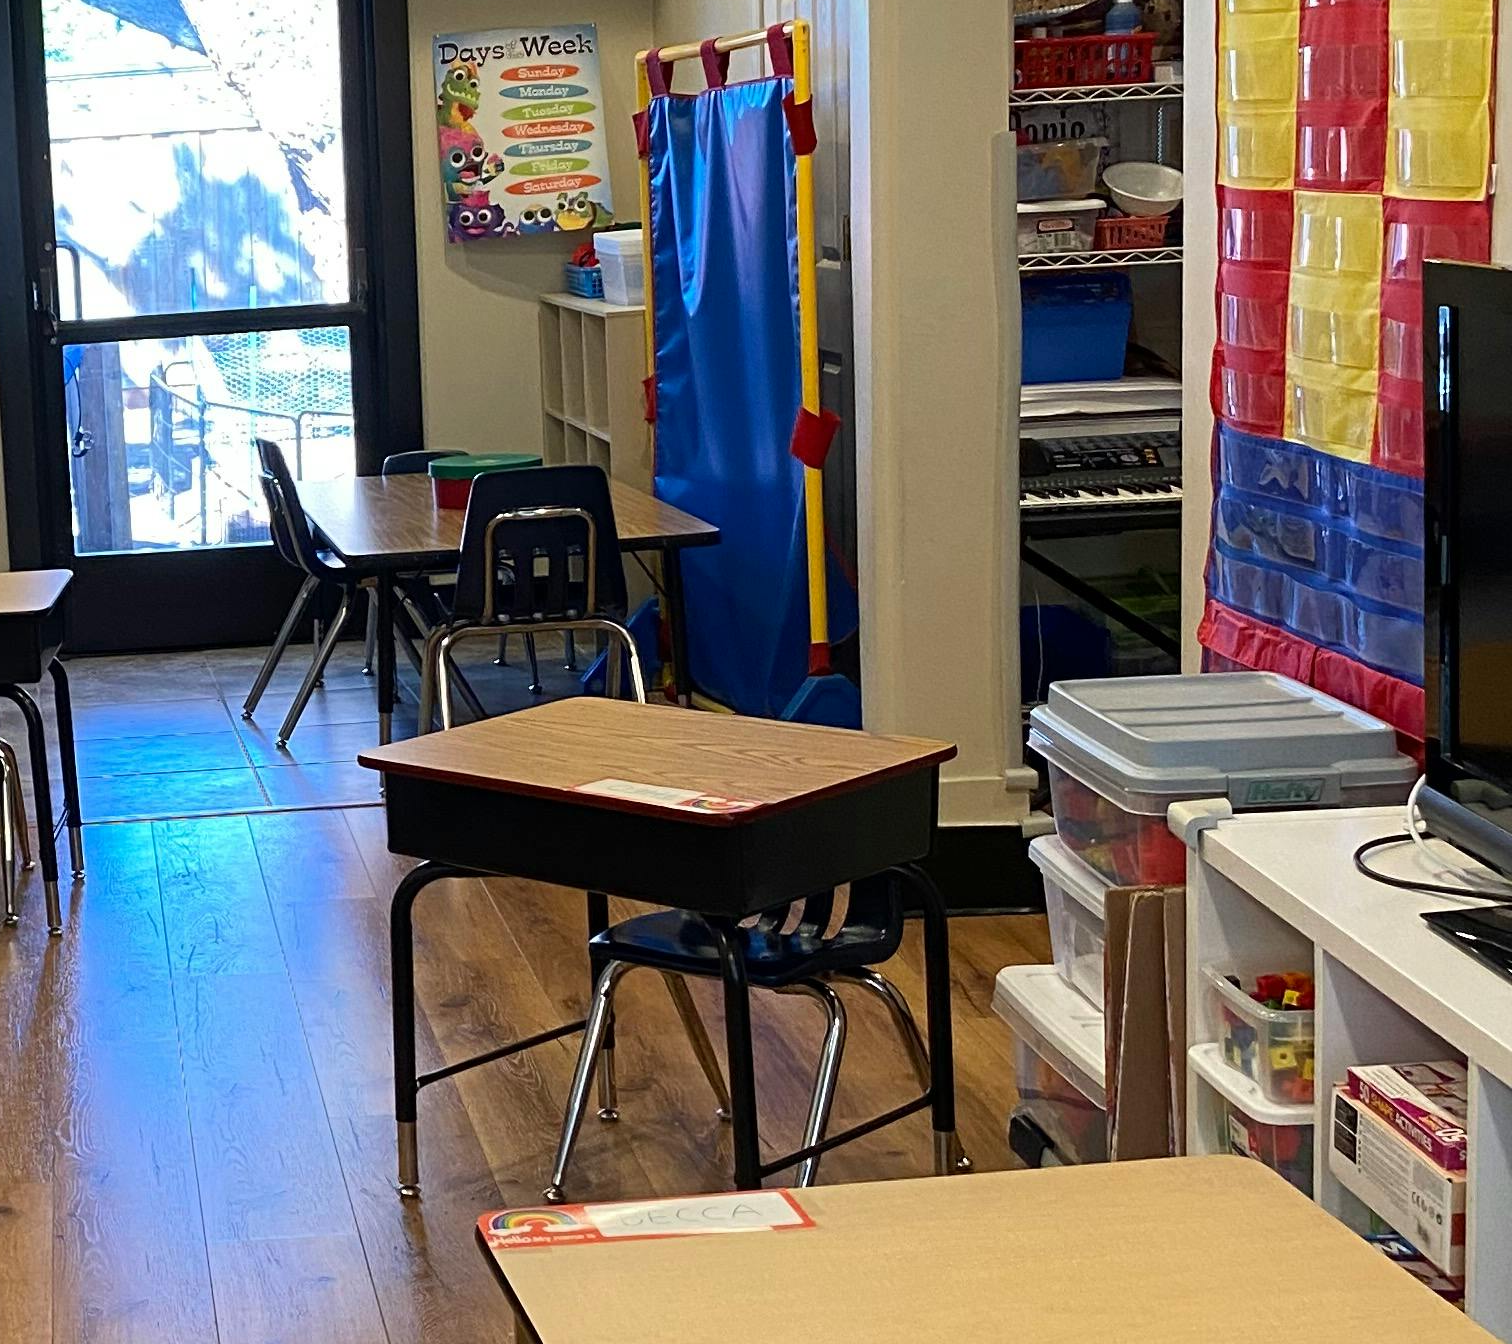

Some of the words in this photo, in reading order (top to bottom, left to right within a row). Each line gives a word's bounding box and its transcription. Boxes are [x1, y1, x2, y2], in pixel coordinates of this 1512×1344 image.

[438, 42, 505, 67] Days
[520, 34, 593, 57] Week
[517, 67, 566, 80] Sunday
[519, 85, 570, 98] Monday
[522, 103, 575, 119] Tuesday
[514, 122, 585, 136] Wednesday
[518, 141, 579, 155] Thursday
[530, 160, 574, 173] Friday
[522, 177, 583, 194] Saturday
[1249, 782, 1320, 801] Hefty
